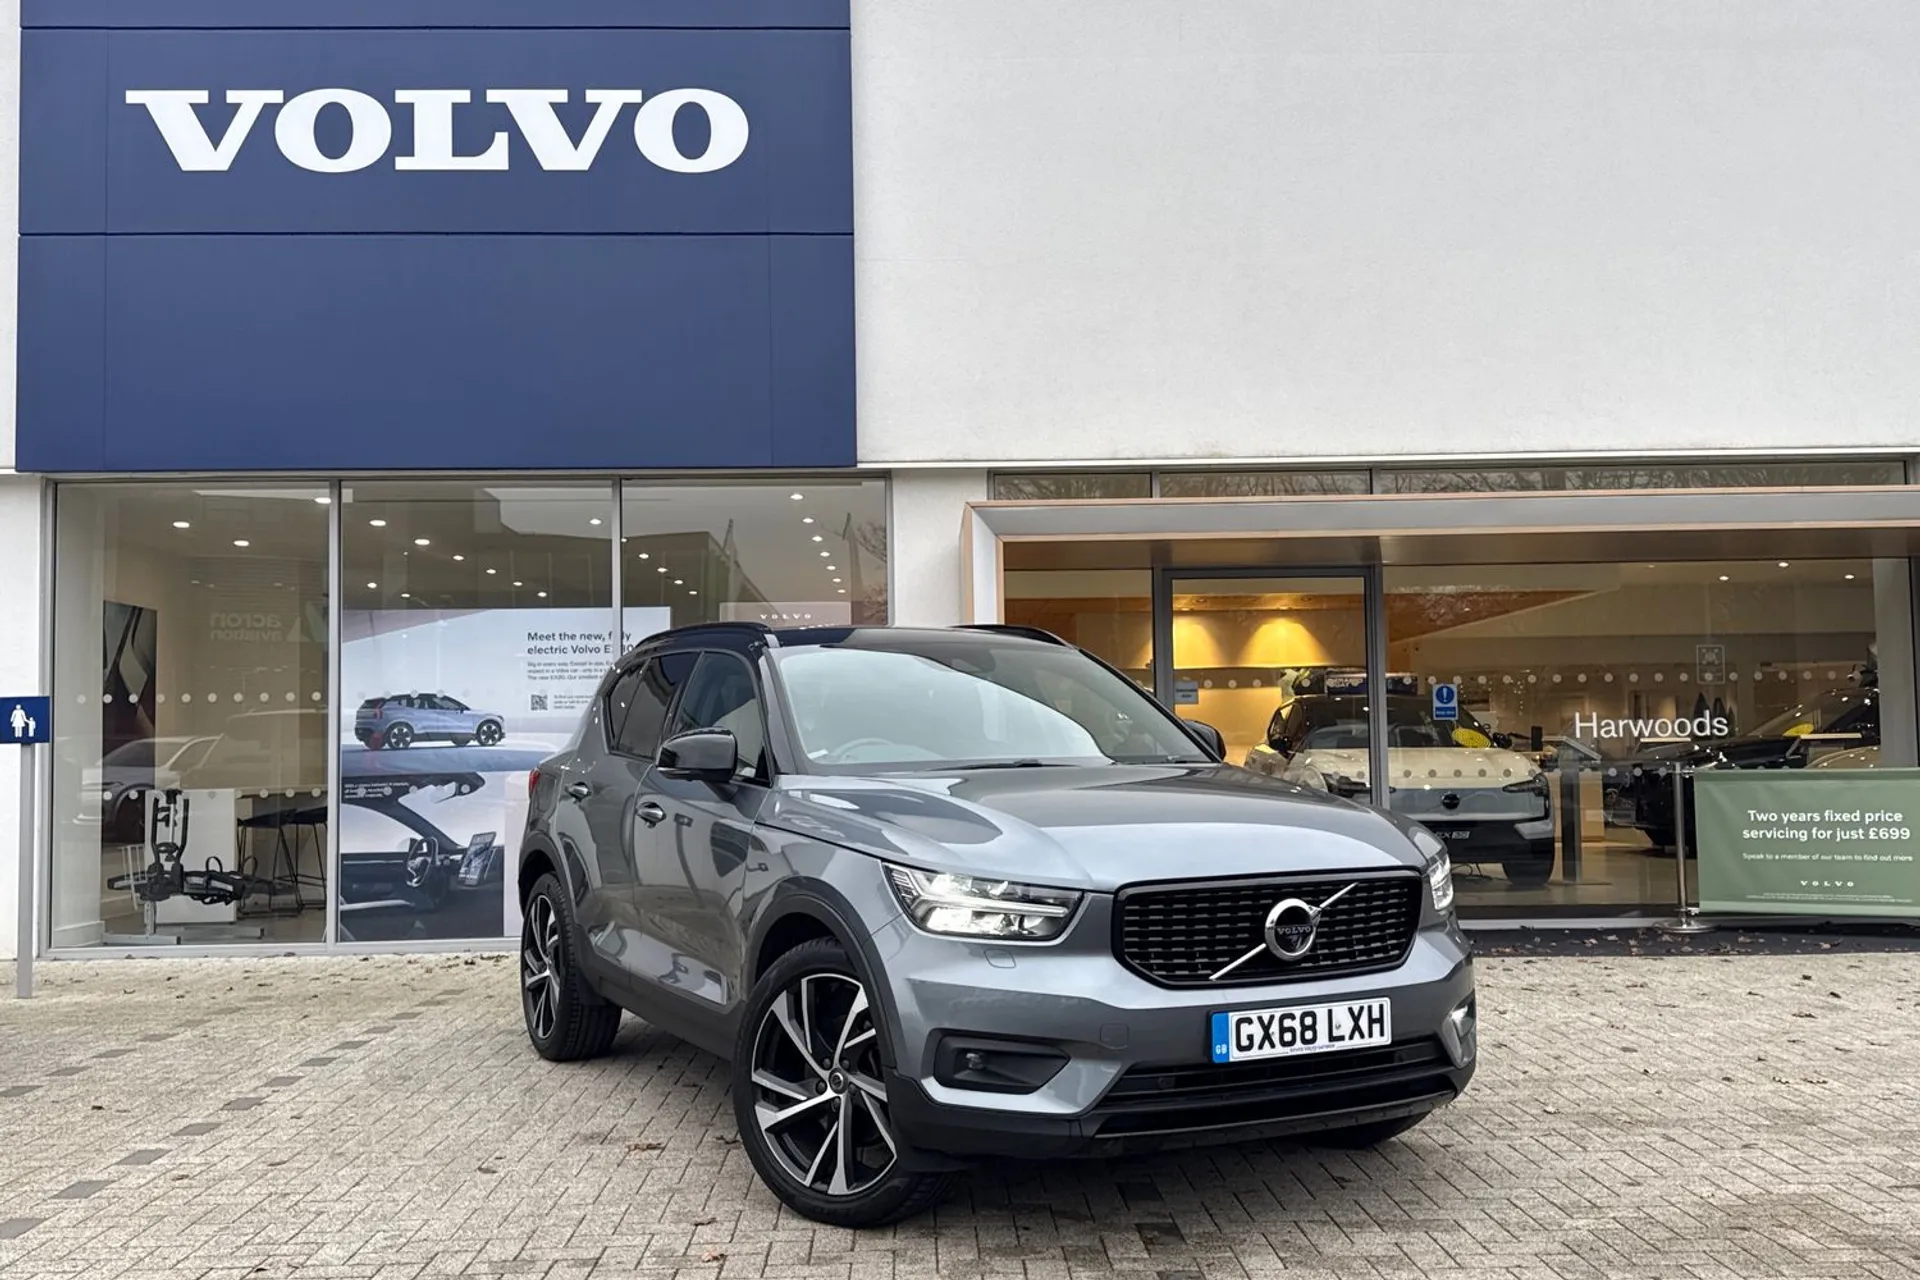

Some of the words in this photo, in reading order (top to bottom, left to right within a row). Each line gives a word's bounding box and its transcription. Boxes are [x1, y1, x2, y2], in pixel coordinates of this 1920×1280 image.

[125, 88, 749, 173] VOLVO
[527, 632, 556, 641] Meet
[559, 631, 577, 641] the
[580, 633, 605, 642] new,
[527, 645, 568, 654] electric
[571, 644, 600, 654] Volvo
[1574, 710, 1729, 739] Harwoods
[1747, 810, 1778, 822] Two
[1781, 812, 1821, 824] years
[1823, 809, 1860, 822] fixed
[1865, 809, 1903, 824] price
[1742, 827, 1808, 842] servicing
[1811, 827, 1833, 839] for
[1836, 827, 1864, 842] just
[1869, 827, 1910, 840] £699
[1743, 853, 1764, 861] Speak
[1863, 853, 1878, 862] find
[1277, 926, 1311, 934] VOLVO
[1235, 1010, 1317, 1052] GX68
[1327, 1003, 1385, 1043] LXH
[1215, 1044, 1227, 1054] GB
